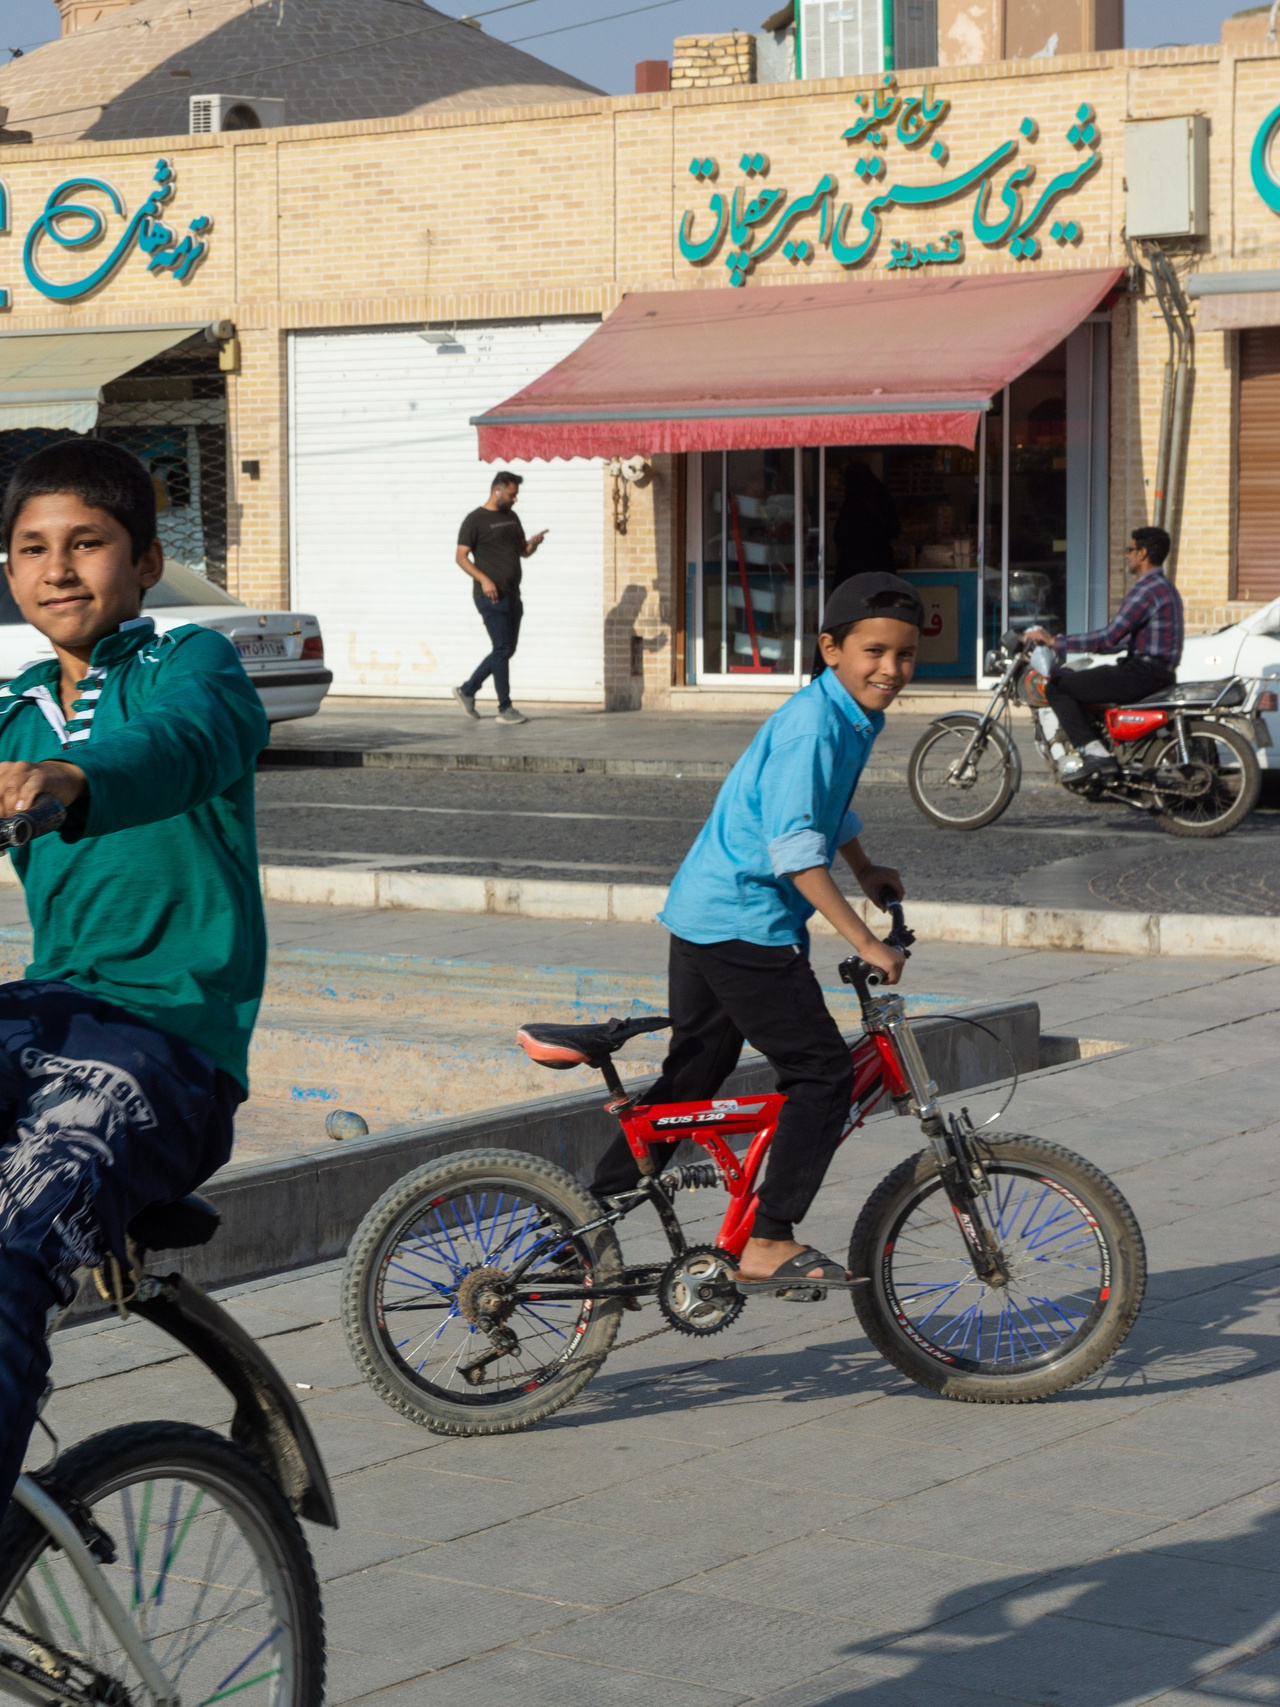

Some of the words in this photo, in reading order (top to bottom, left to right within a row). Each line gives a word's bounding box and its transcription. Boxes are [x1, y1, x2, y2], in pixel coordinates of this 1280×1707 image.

[841, 74, 899, 145] خلیفه
[896, 84, 948, 145] حاج
[831, 140, 1016, 265] سنتی
[972, 102, 1099, 258] شیرینی
[656, 1115, 693, 1126] SUS
[695, 1112, 726, 1122] 120
[898, 1318, 953, 1361] INTENSE
